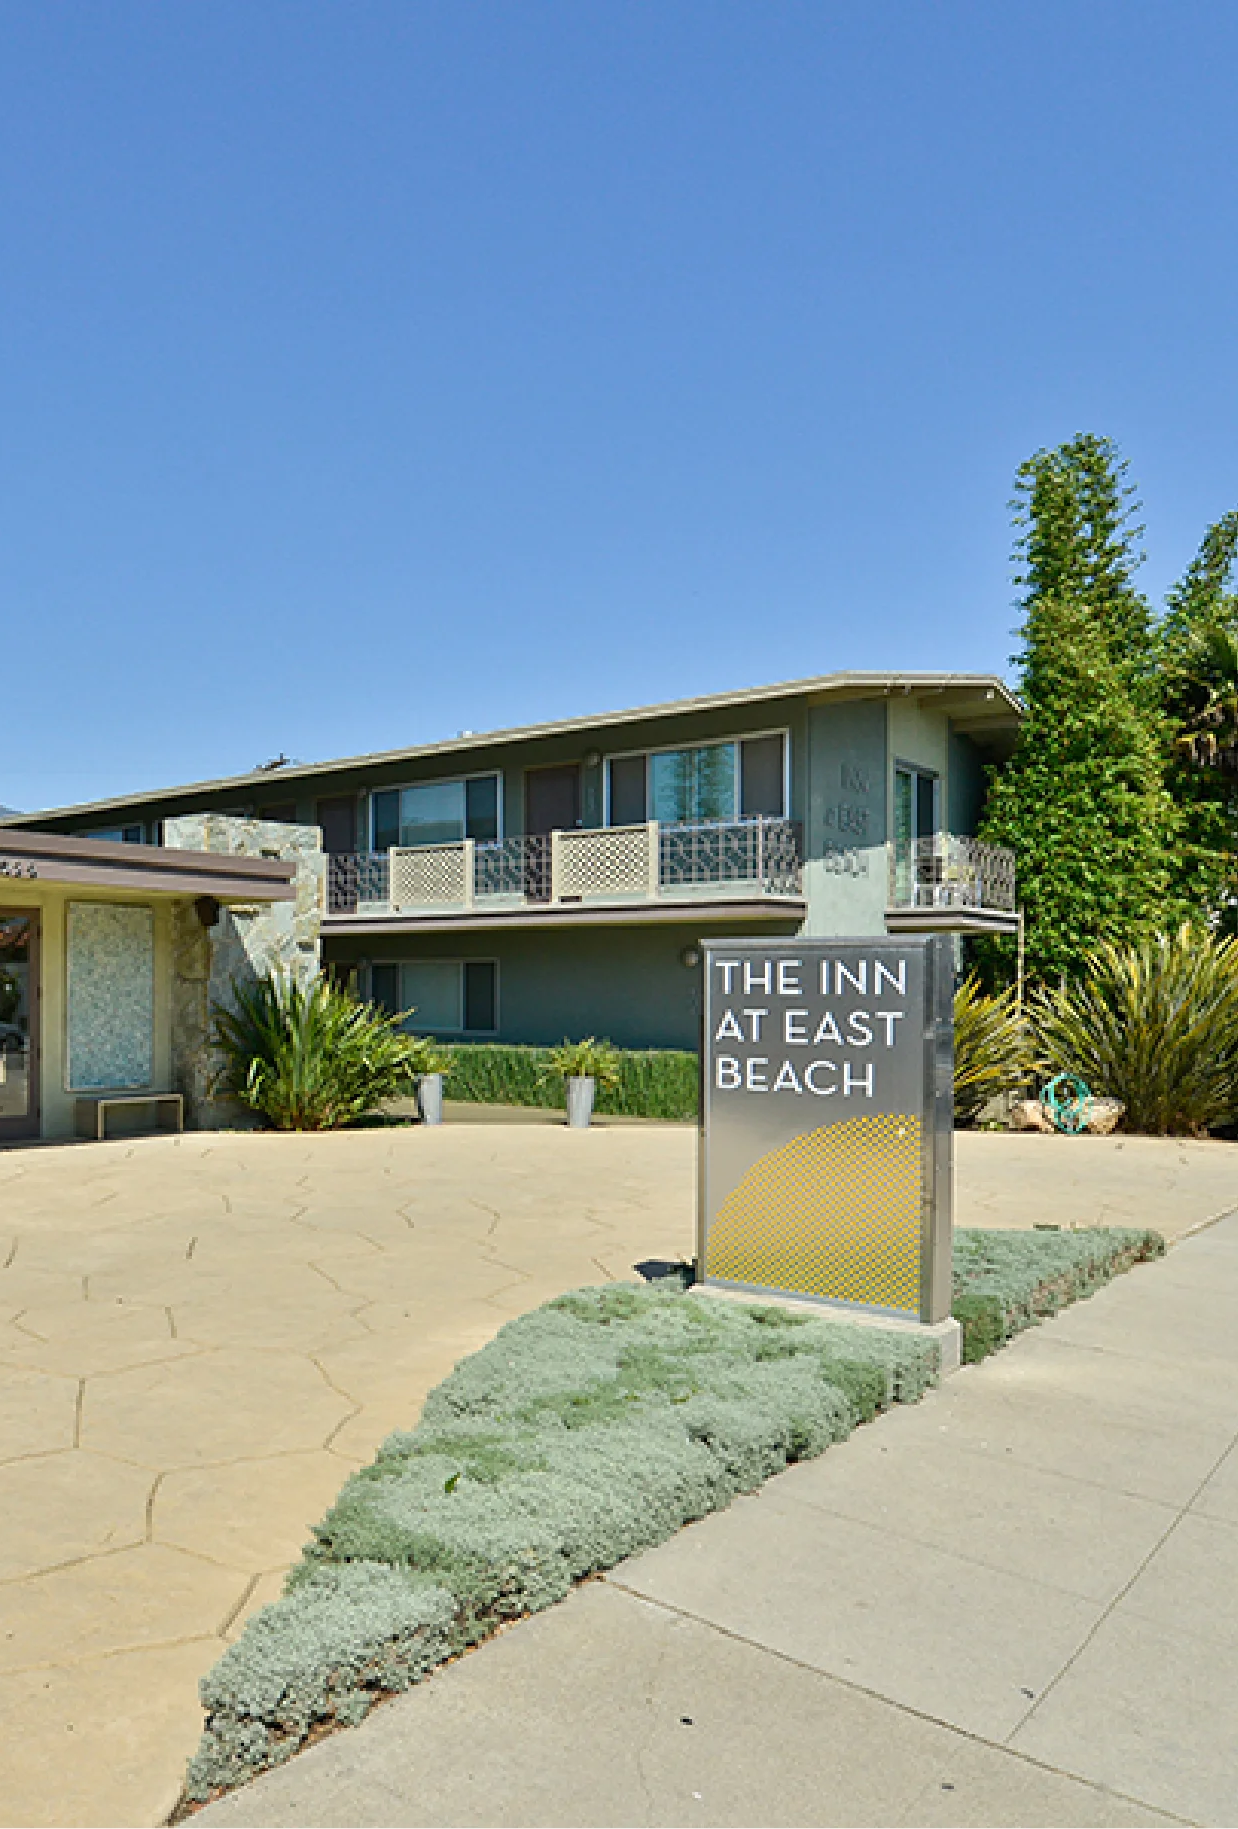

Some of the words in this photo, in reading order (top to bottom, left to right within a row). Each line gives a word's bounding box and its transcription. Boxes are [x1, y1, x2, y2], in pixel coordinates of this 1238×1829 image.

[716, 959, 803, 995] THE
[820, 959, 906, 995] INN
[715, 1008, 769, 1043] AT
[784, 1009, 904, 1046] EAST
[715, 1055, 873, 1098] BEACH
